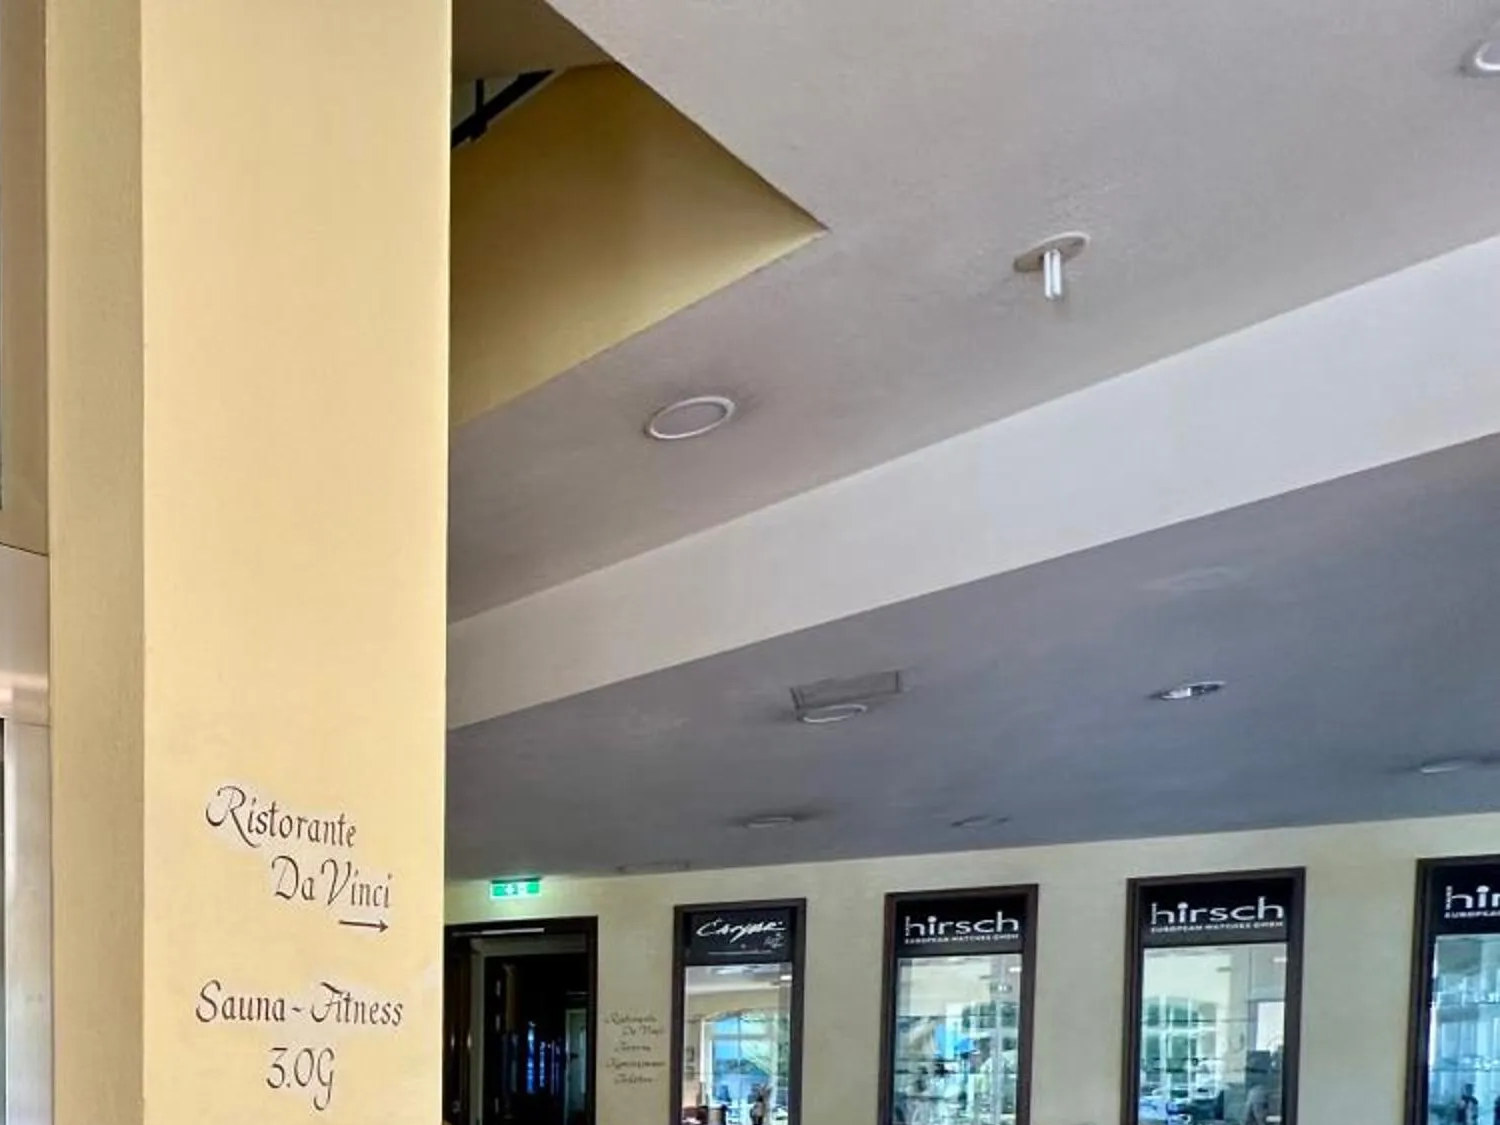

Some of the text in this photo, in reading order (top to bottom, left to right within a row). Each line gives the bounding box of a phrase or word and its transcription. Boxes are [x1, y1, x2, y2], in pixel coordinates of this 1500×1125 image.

[205, 785, 357, 848] Ristorante
[271, 854, 393, 908] Da Vinci
[904, 910, 1020, 937] hirsch
[1150, 896, 1285, 925] hirsch
[195, 980, 286, 1024] Sauna
[310, 980, 403, 1027] Fitness
